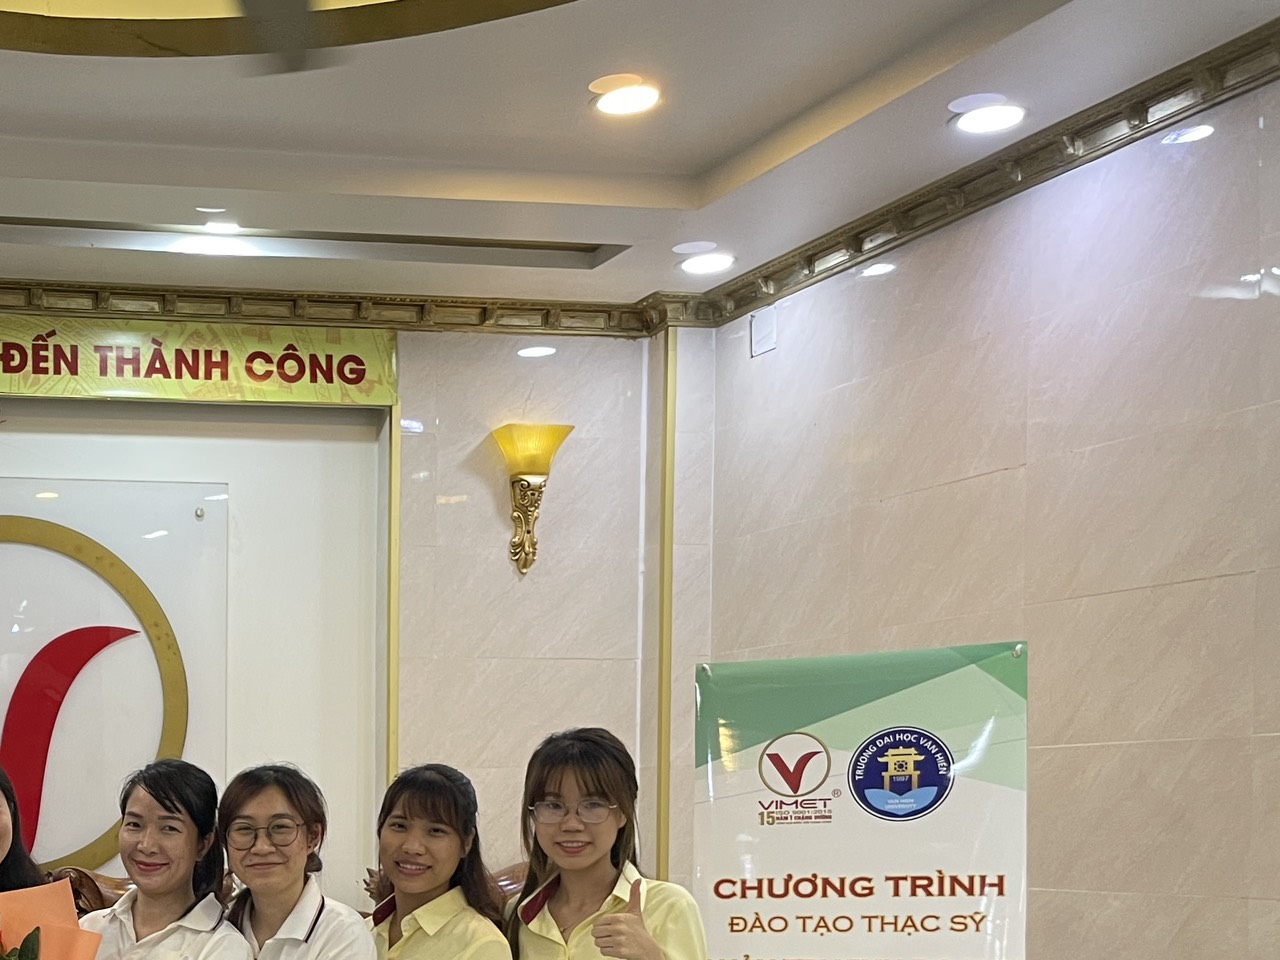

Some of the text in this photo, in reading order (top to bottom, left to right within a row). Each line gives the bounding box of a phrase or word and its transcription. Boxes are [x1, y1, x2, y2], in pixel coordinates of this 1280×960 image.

[0, 329, 79, 376] ĐẾN
[94, 337, 229, 381] THÀNH
[245, 343, 366, 385] CÔNG
[758, 798, 832, 810] VIMET
[758, 811, 776, 826] 15
[713, 869, 1005, 899] CHƯƠNG TRÌNH
[728, 911, 987, 936] ĐÀO TẠO THẠC SỸ
